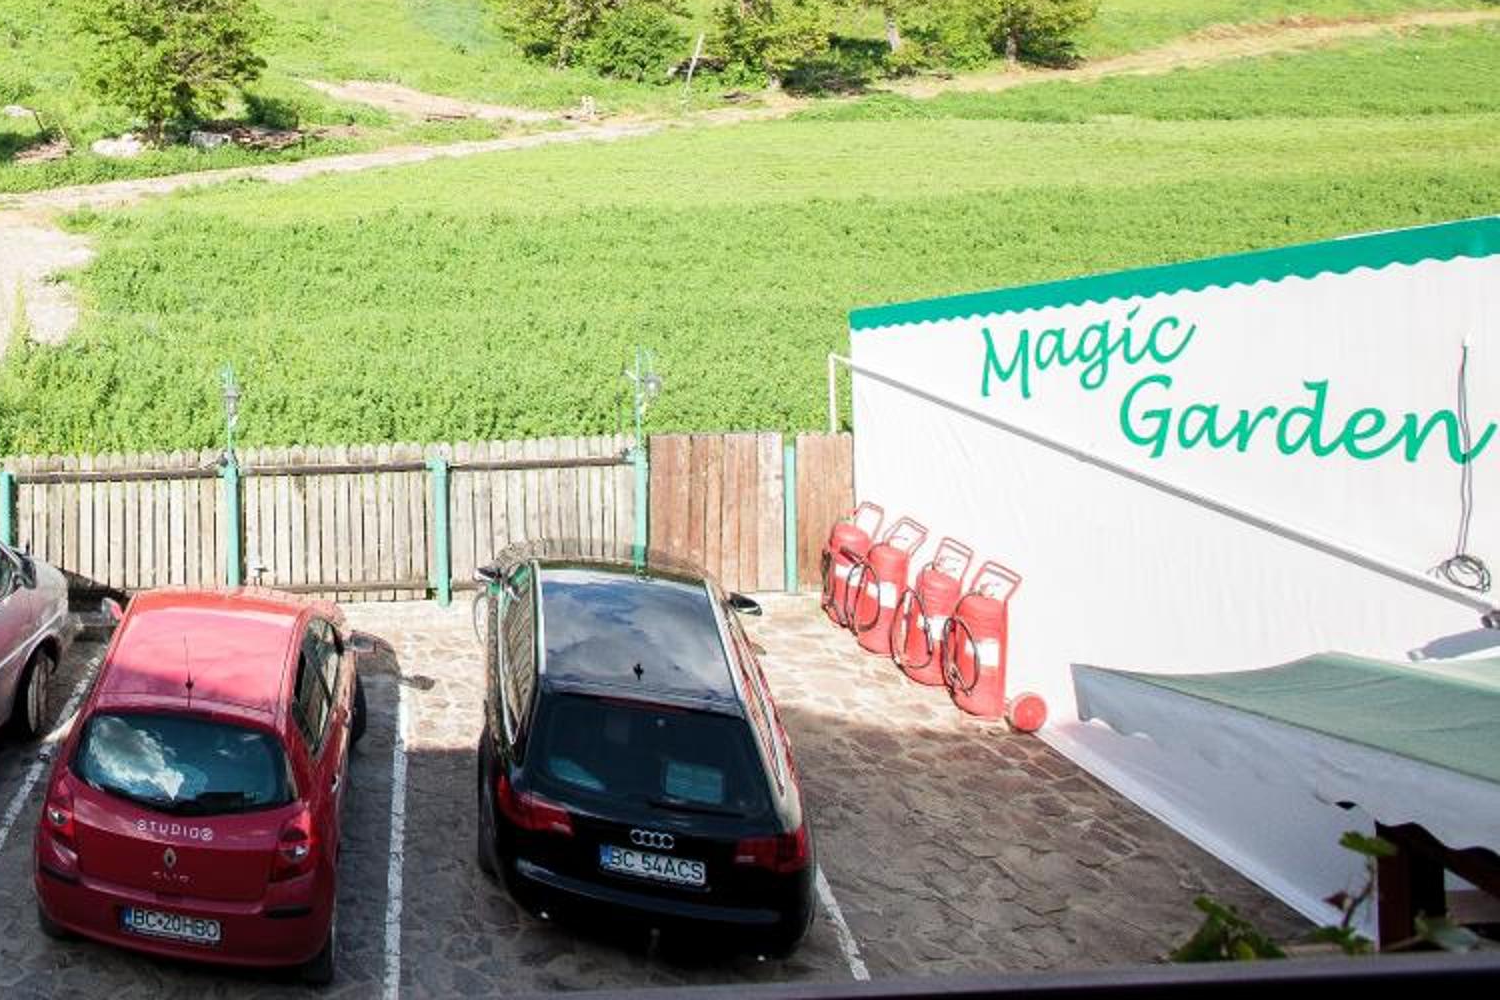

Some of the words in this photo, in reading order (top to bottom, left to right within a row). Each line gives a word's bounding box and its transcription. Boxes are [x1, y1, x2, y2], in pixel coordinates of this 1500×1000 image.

[981, 304, 1197, 399] Magic
[1118, 374, 1497, 465] Garden
[611, 848, 635, 869] BC
[642, 853, 704, 881] 54ACS
[133, 907, 157, 929] BC
